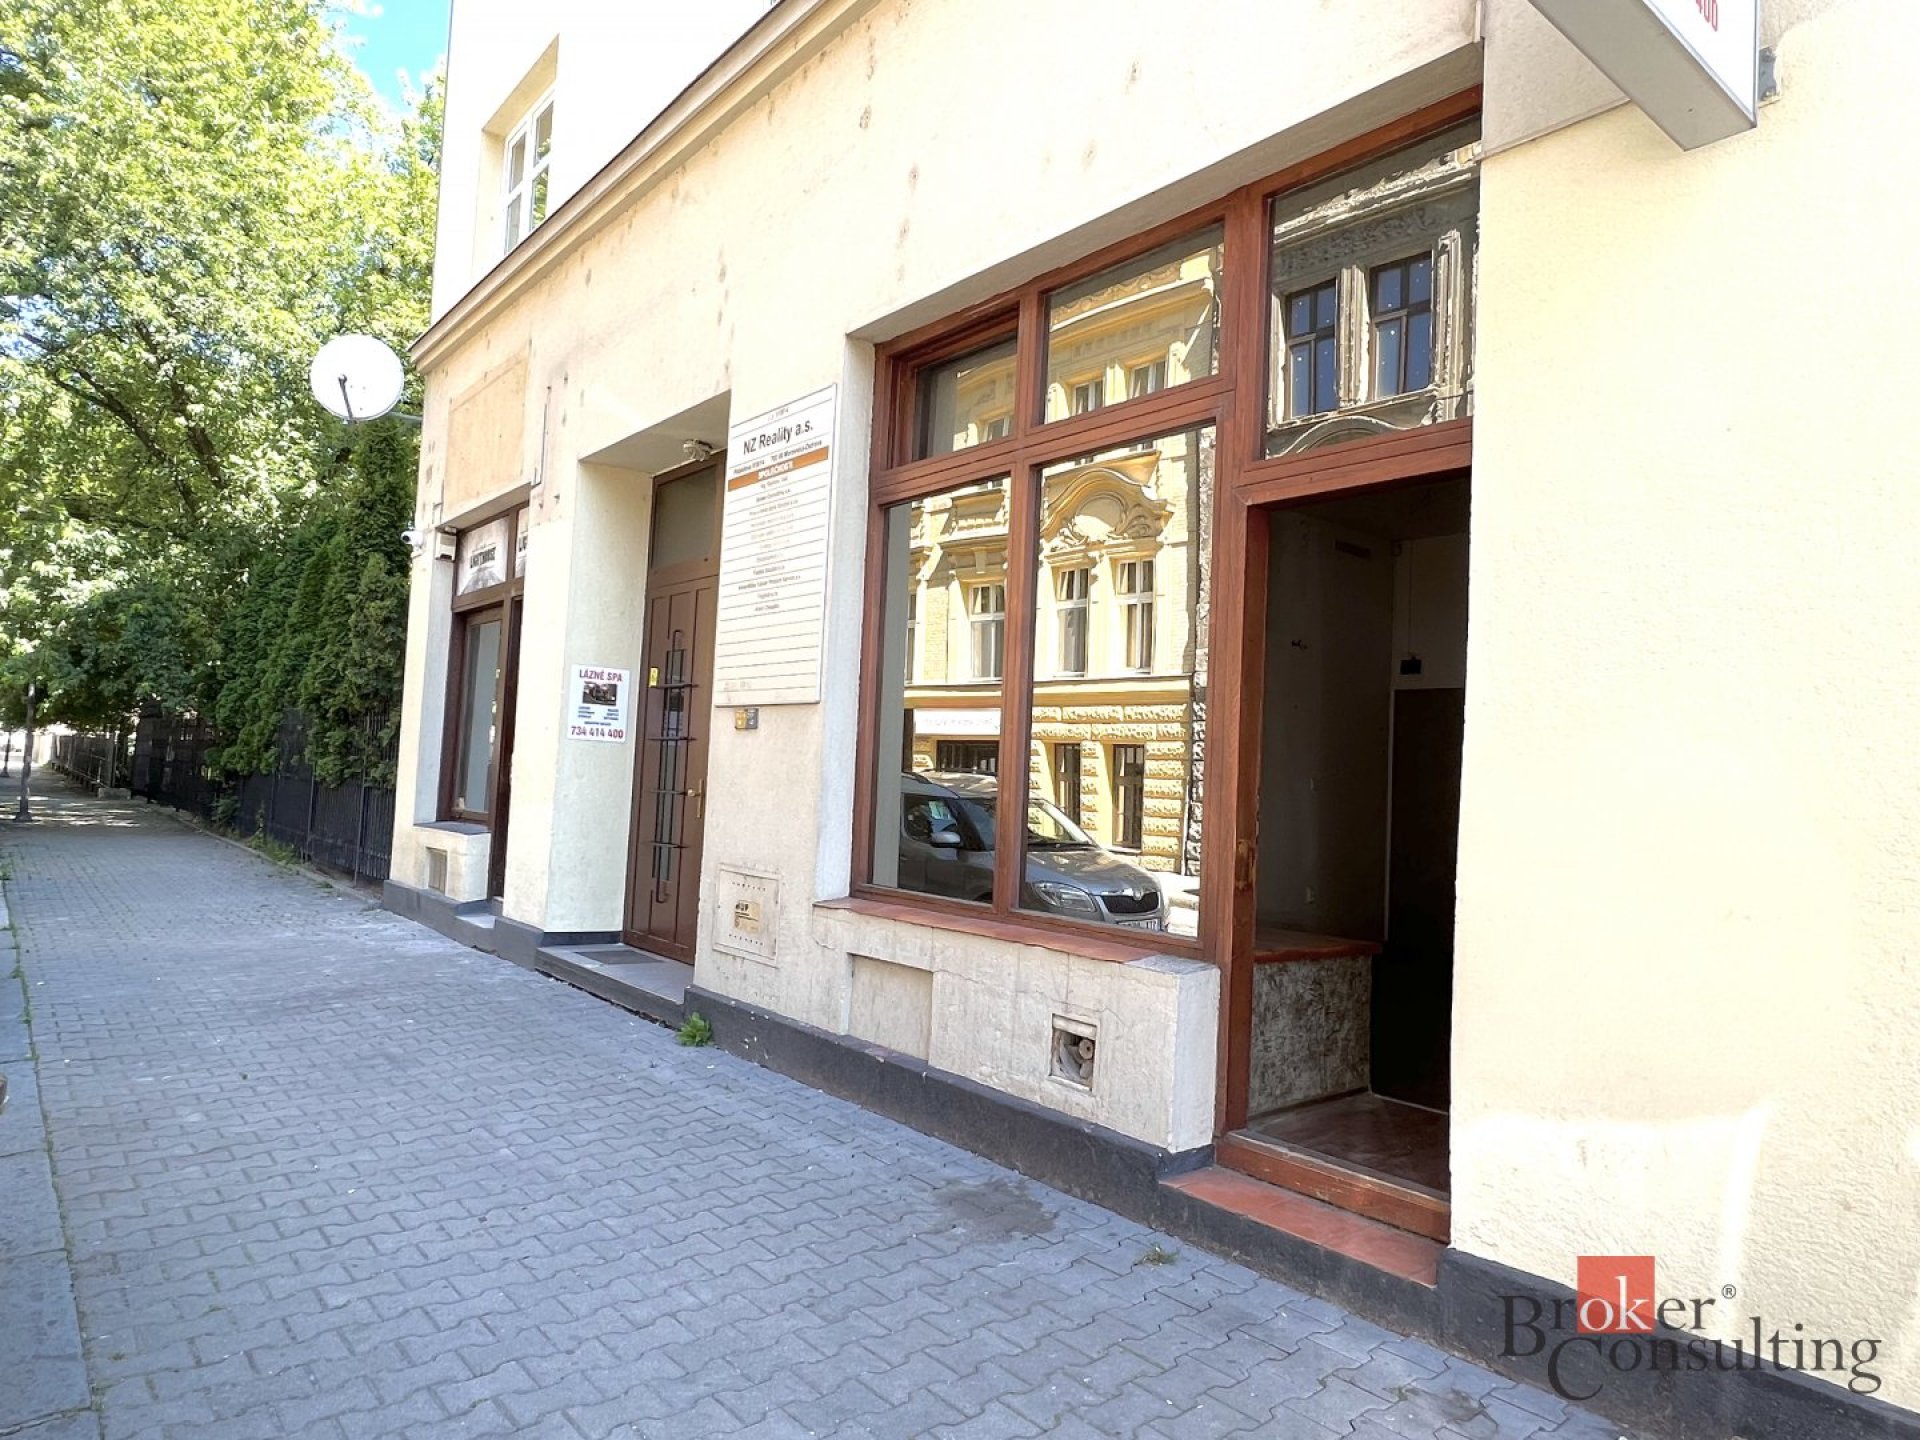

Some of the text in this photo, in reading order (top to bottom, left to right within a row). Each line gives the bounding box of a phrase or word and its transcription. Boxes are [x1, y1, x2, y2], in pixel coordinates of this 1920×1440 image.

[743, 437, 757, 456] NZ
[759, 427, 792, 450] Reality
[795, 420, 813, 437] a.s.
[607, 671, 623, 682] SPA
[571, 726, 624, 739] 734 414 400
